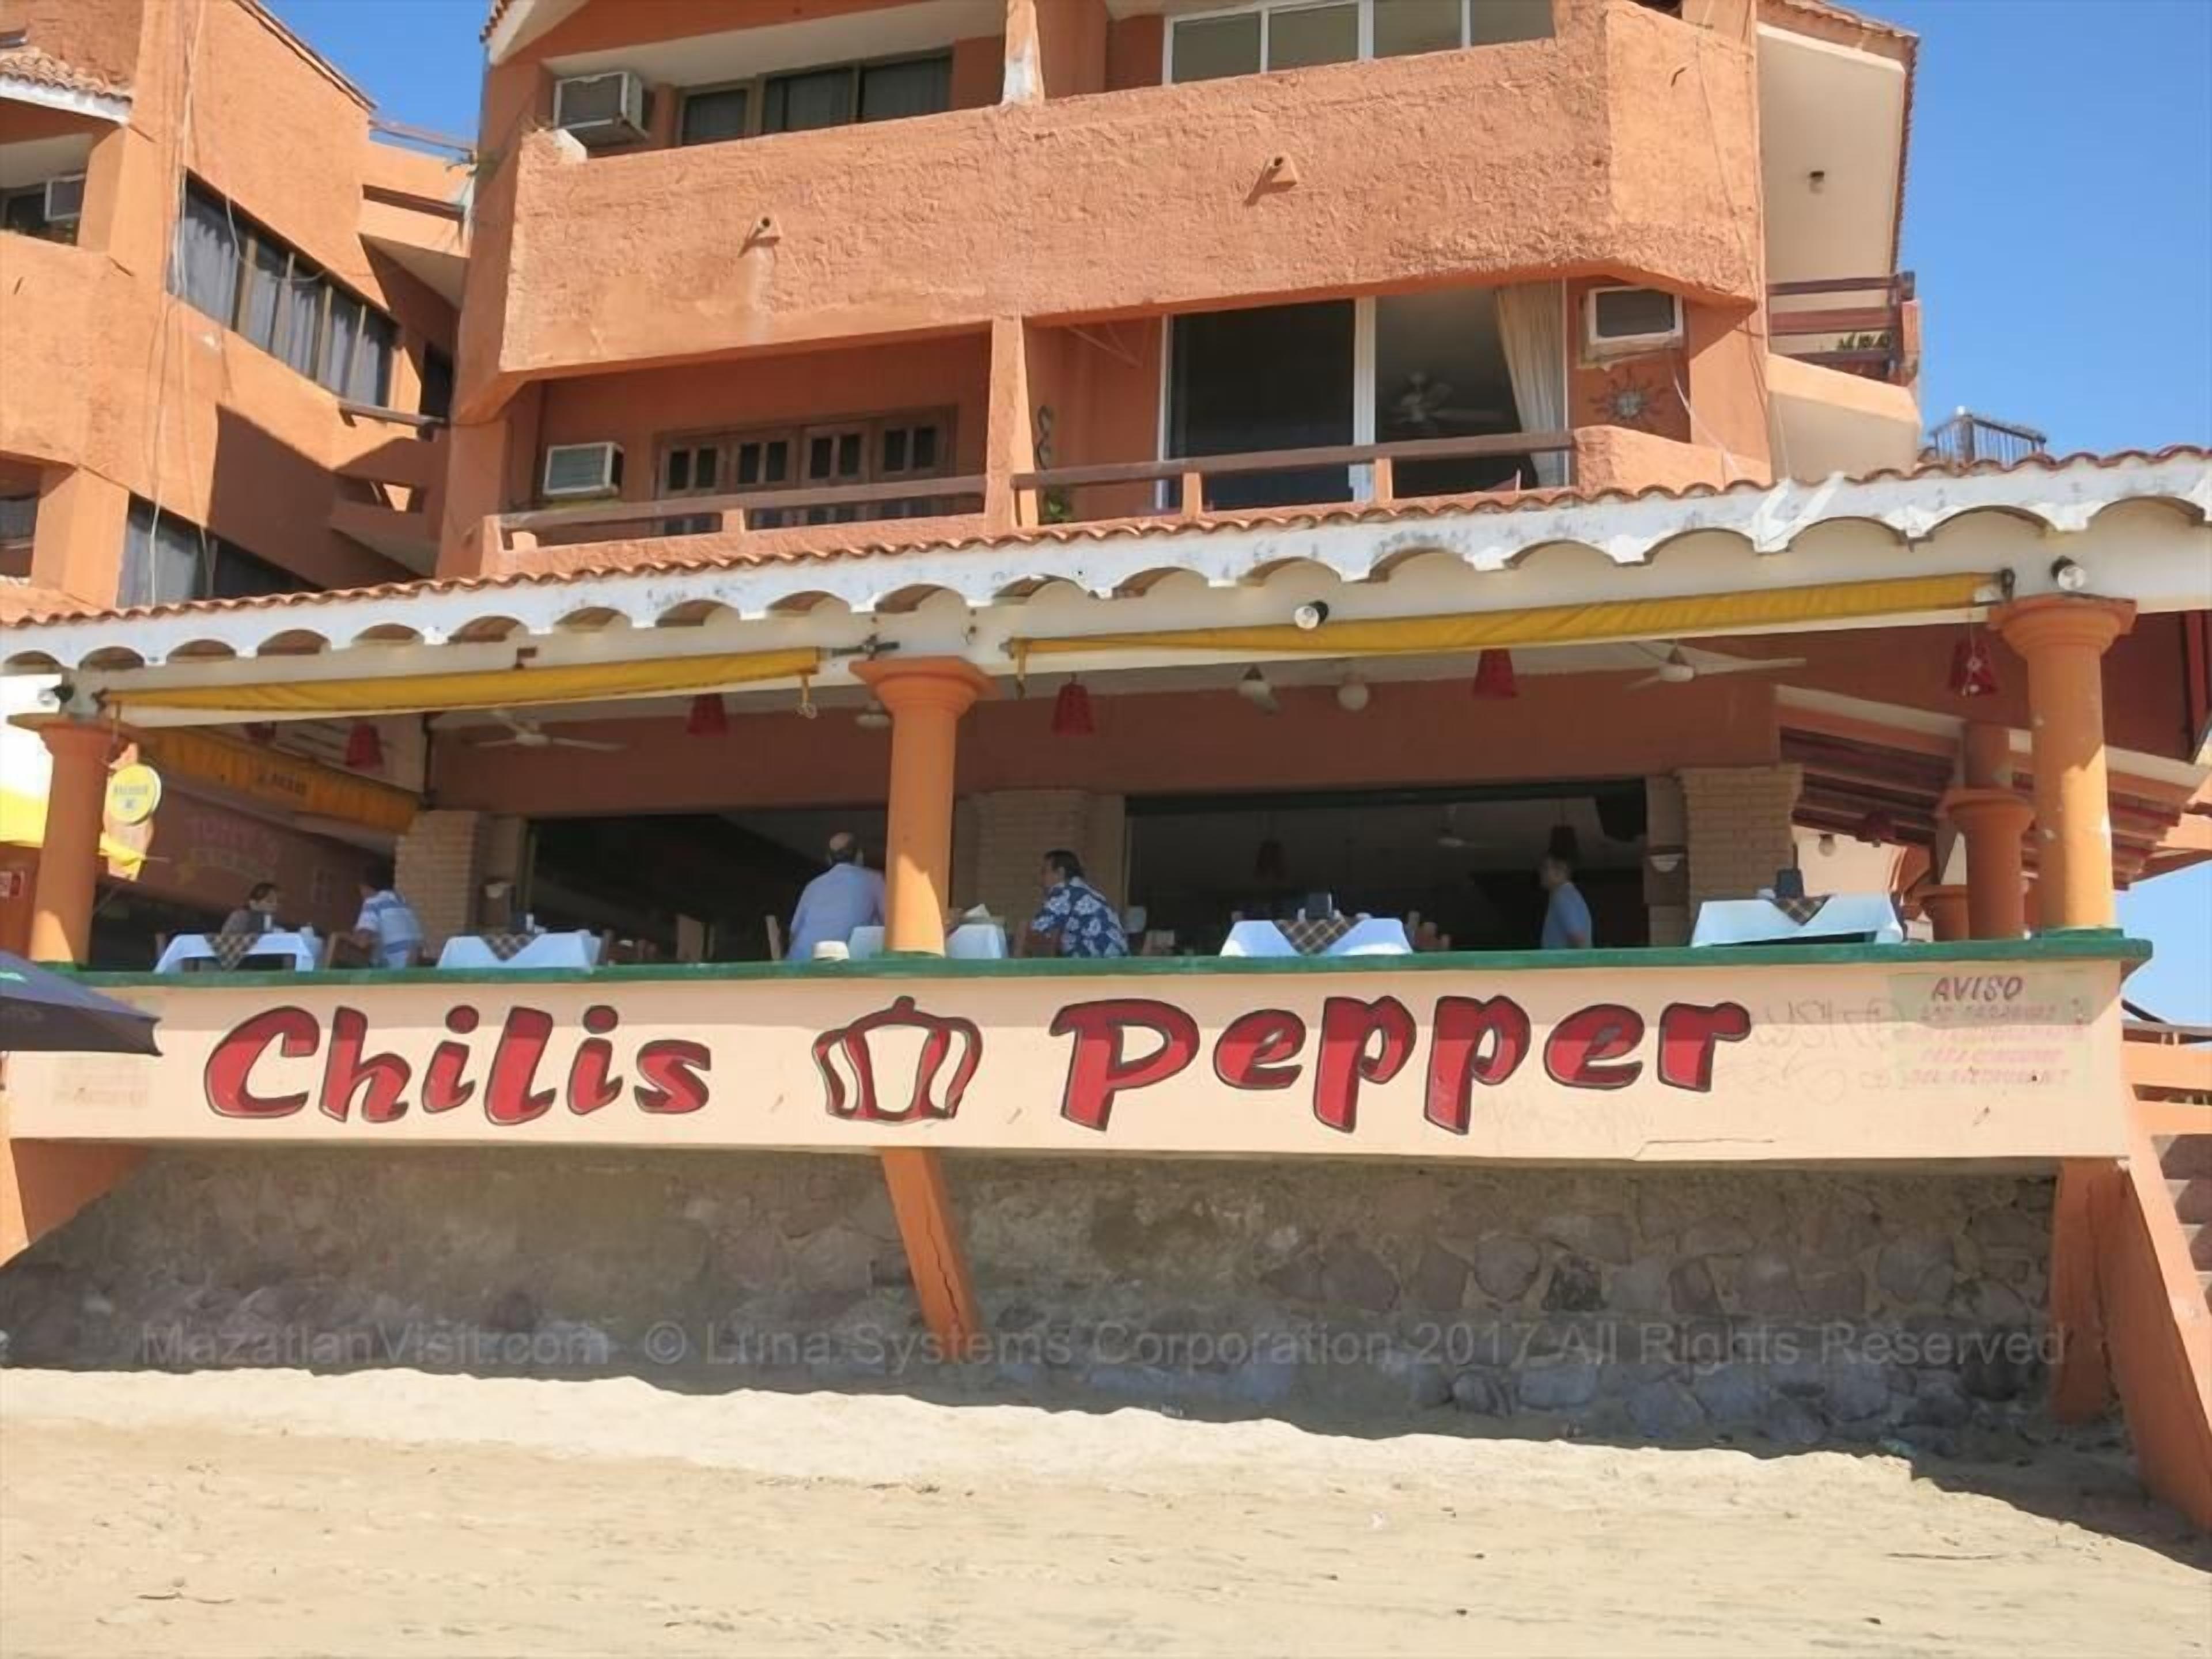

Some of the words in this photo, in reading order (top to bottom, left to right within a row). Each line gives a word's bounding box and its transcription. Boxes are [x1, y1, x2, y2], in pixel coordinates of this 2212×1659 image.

[1931, 976, 2024, 1002] AVISO
[203, 1004, 712, 1126] Chilis
[1048, 994, 1752, 1135] Pepper
